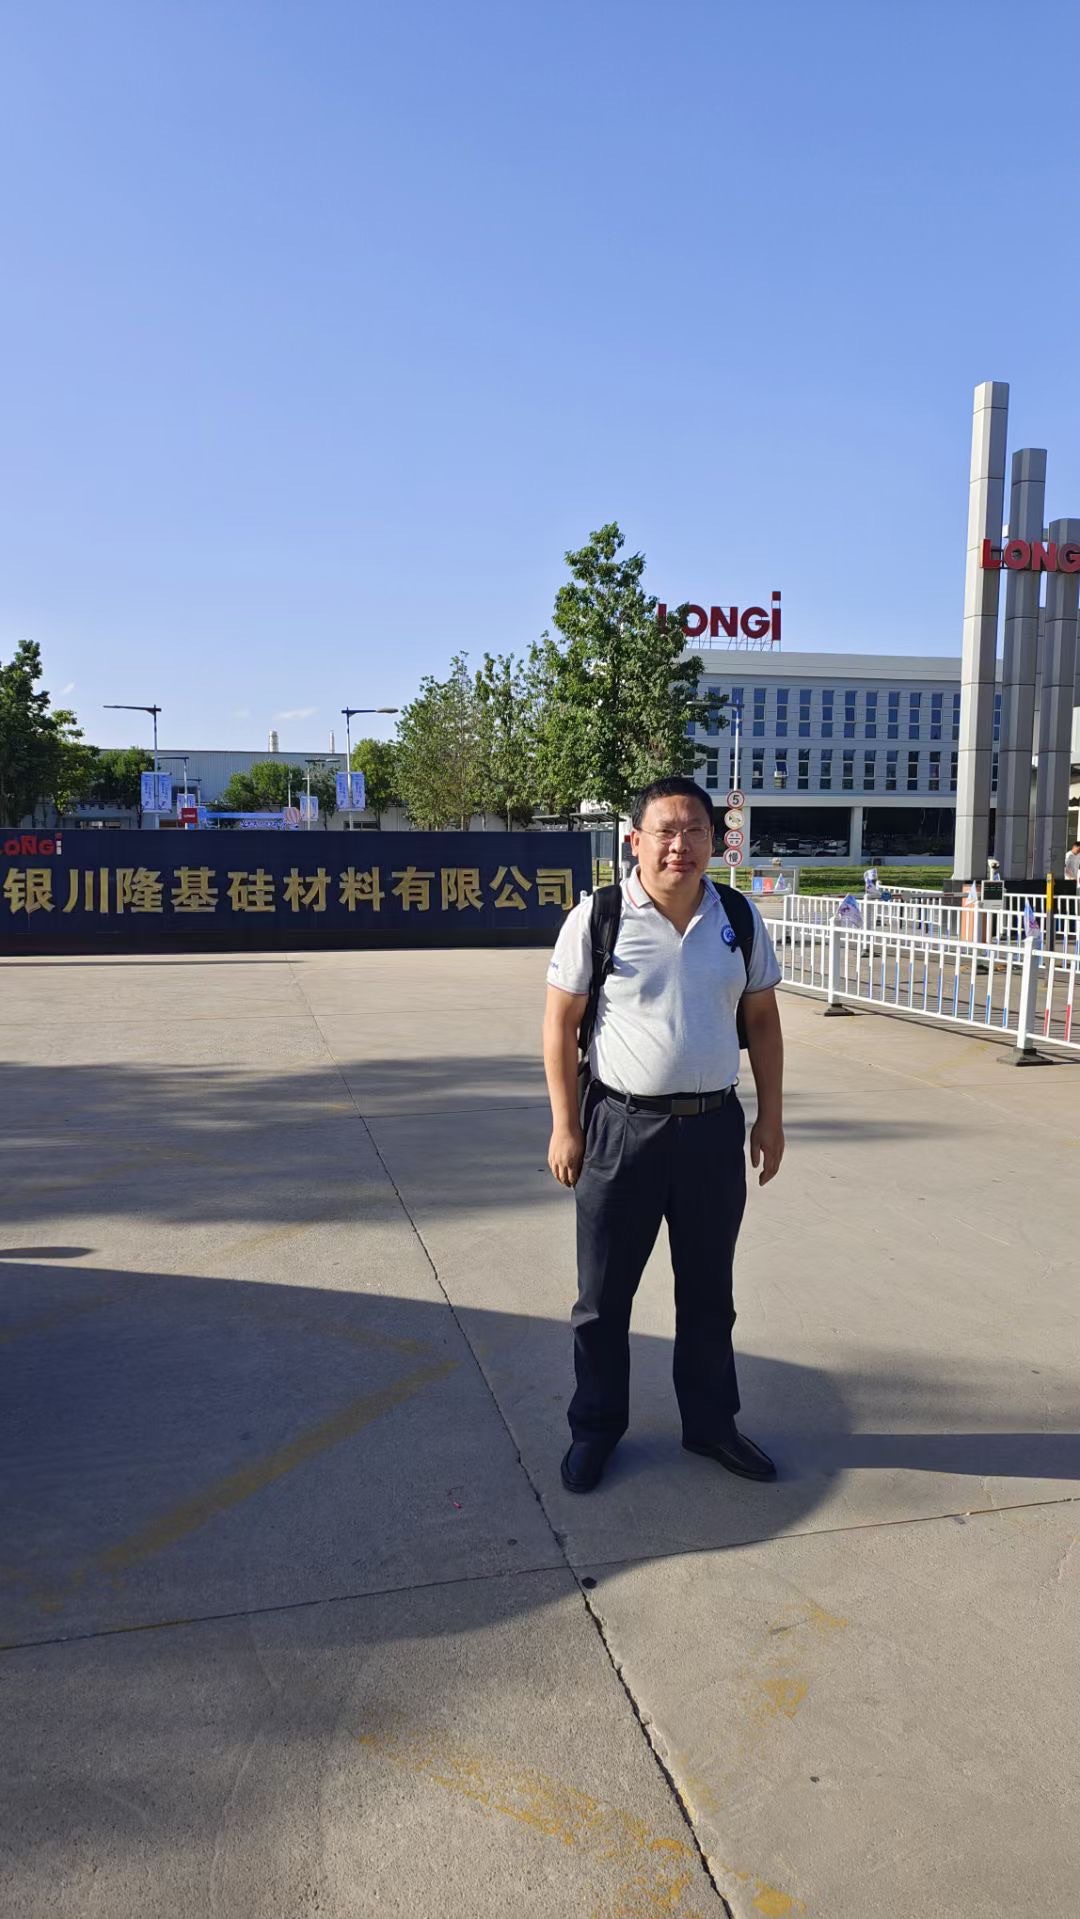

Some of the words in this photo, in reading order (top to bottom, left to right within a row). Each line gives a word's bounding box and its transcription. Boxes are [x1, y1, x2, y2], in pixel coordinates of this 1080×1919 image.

[732, 794, 740, 805] 5
[0, 832, 62, 856] ONGi
[3, 866, 574, 914] 银川隆基硅材料有限公司
